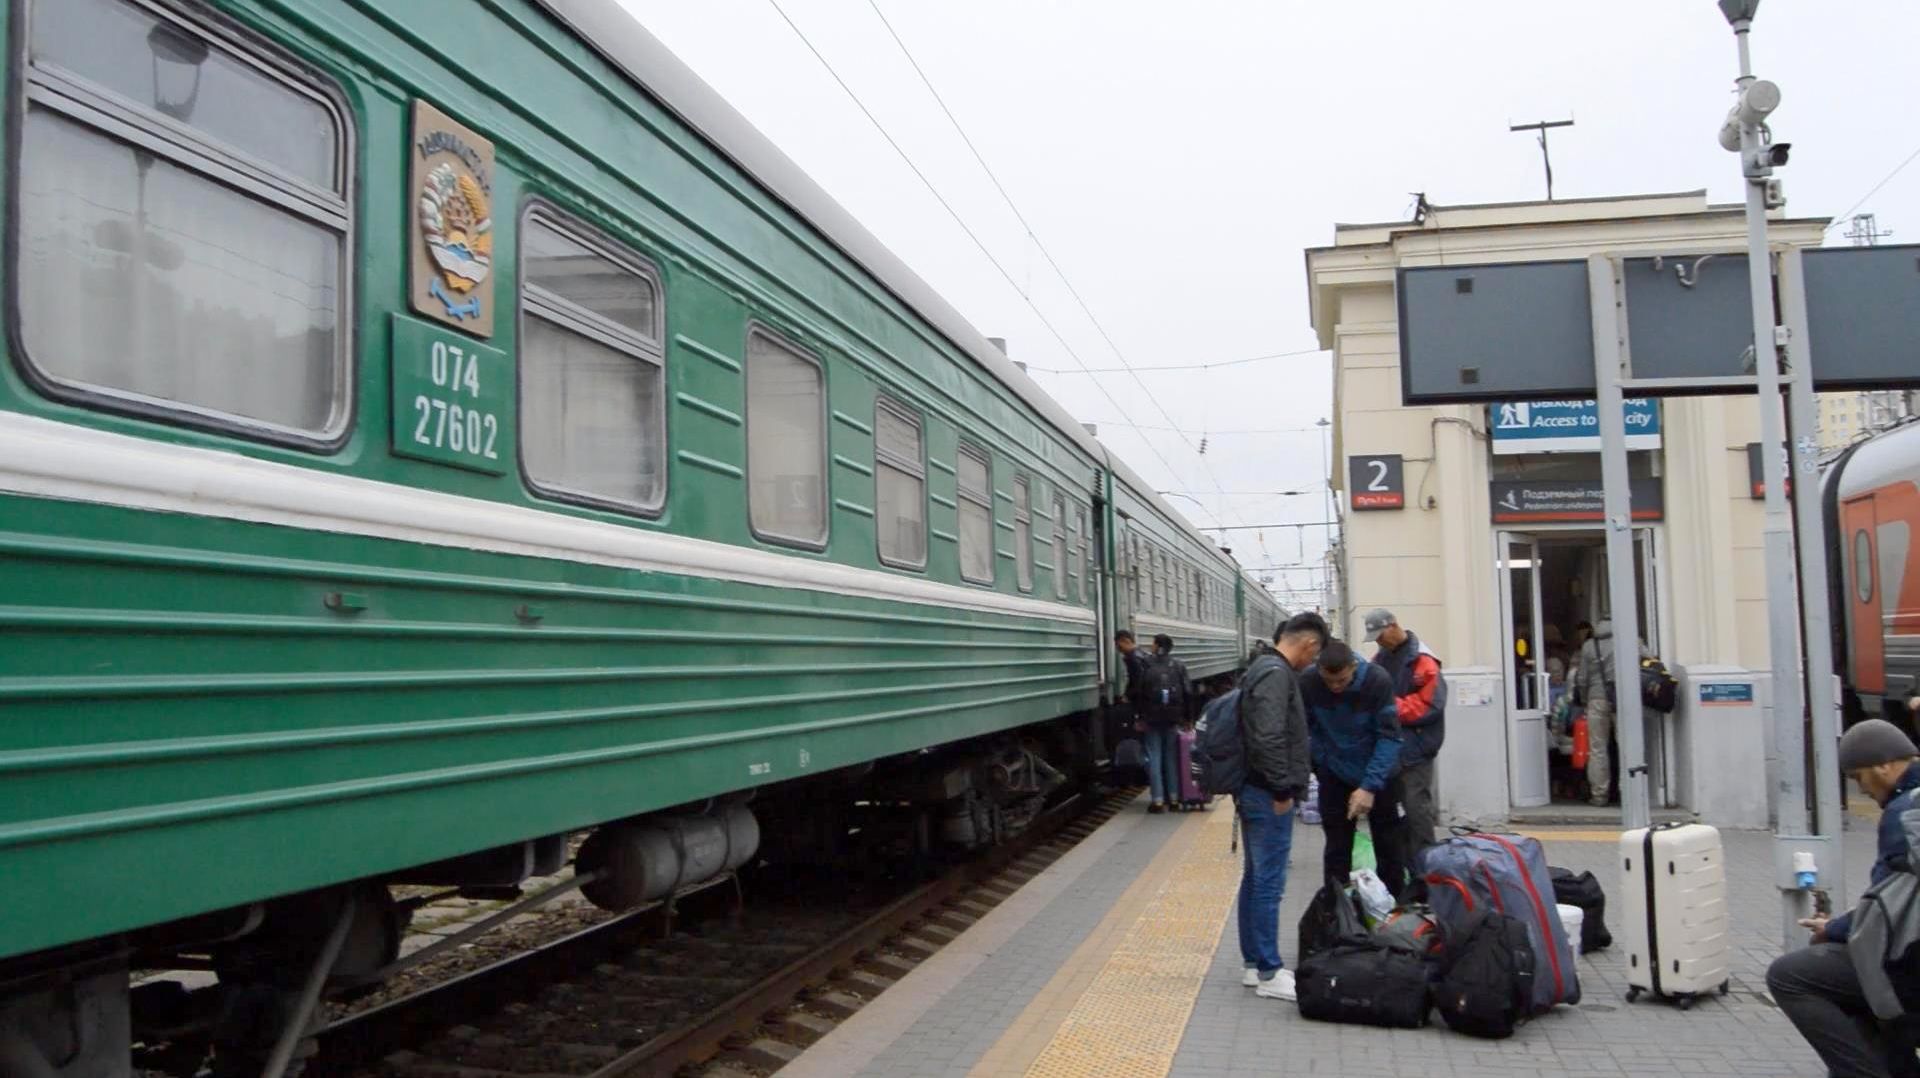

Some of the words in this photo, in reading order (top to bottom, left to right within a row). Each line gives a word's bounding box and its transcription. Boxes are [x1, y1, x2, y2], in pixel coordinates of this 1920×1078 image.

[431, 341, 480, 398] 074
[414, 395, 498, 460] 27602
[1532, 415, 1578, 428] Access
[1581, 414, 1596, 426] to
[1625, 411, 1653, 427] city
[1367, 460, 1389, 491] 2
